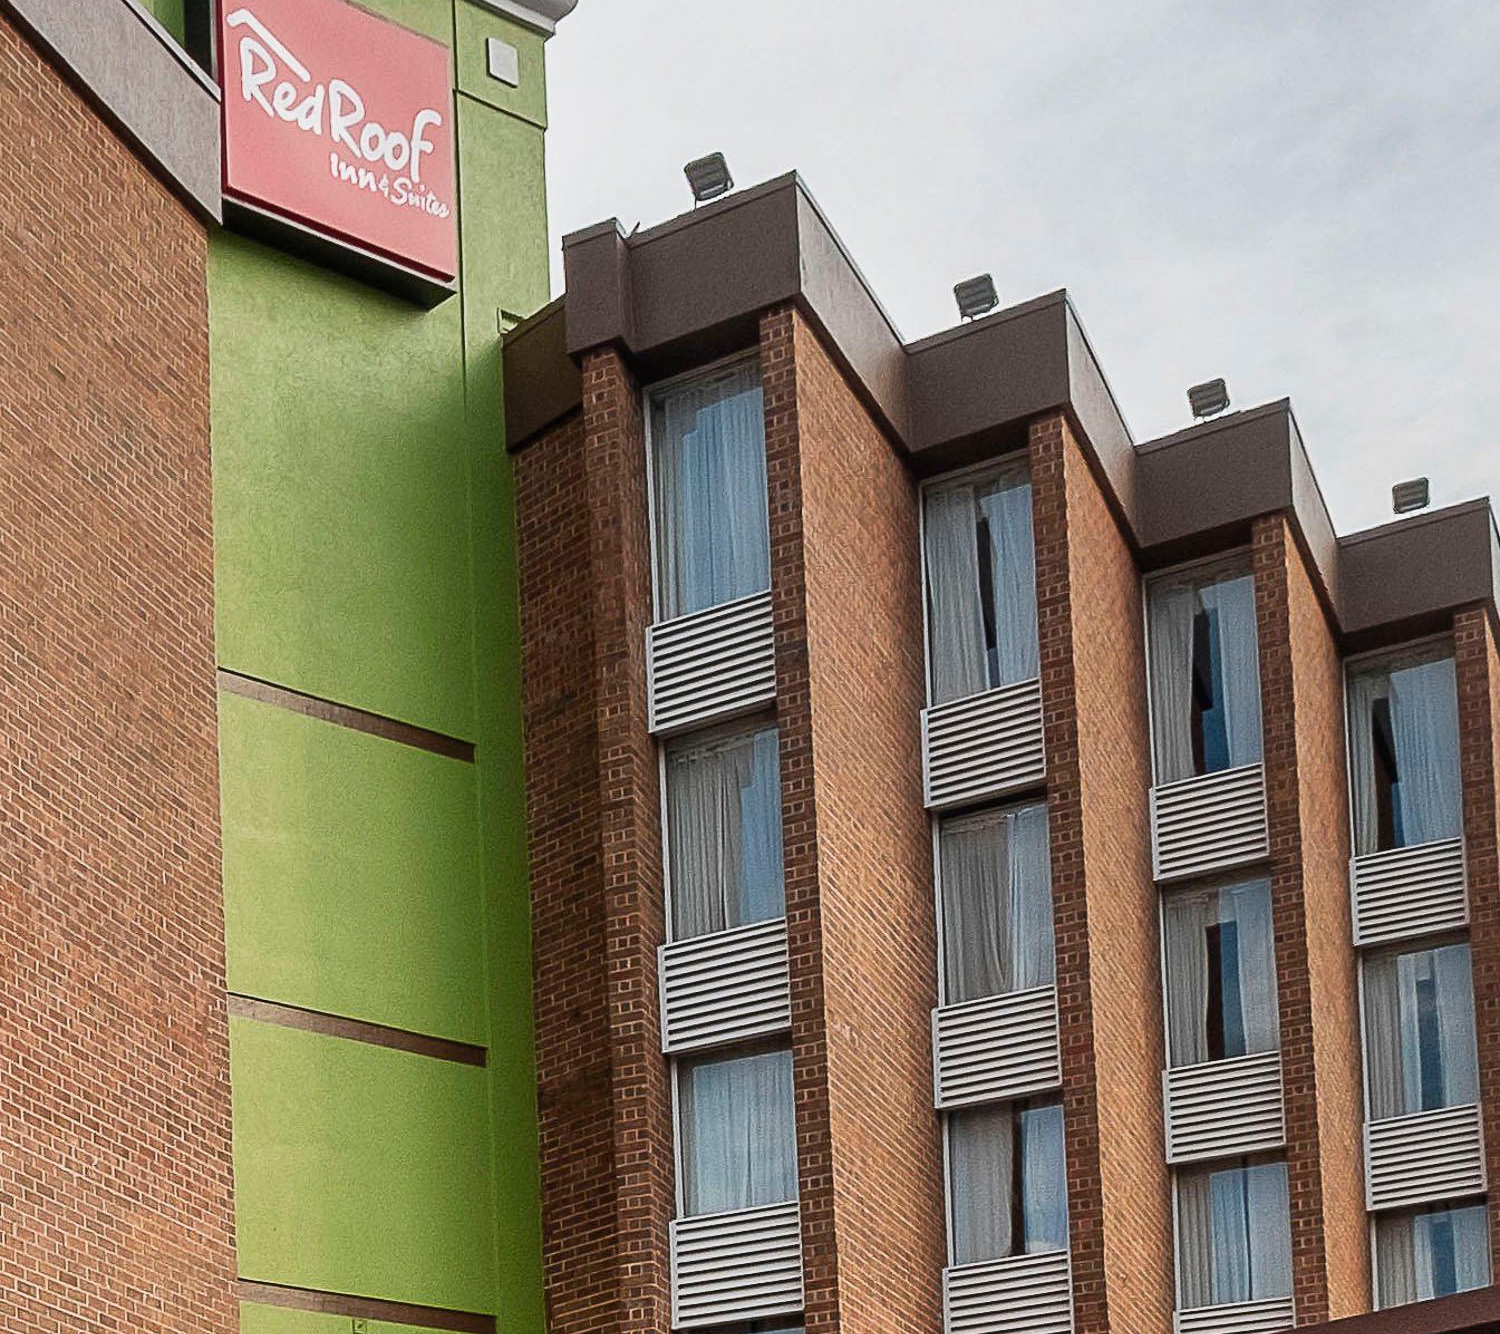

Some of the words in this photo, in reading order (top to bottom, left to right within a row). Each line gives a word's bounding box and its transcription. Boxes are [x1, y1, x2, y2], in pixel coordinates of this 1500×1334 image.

[240, 36, 325, 135] Red
[328, 78, 443, 183] Roof
[330, 152, 377, 193] Inn
[378, 174, 390, 198] &
[390, 177, 449, 218] Suites
